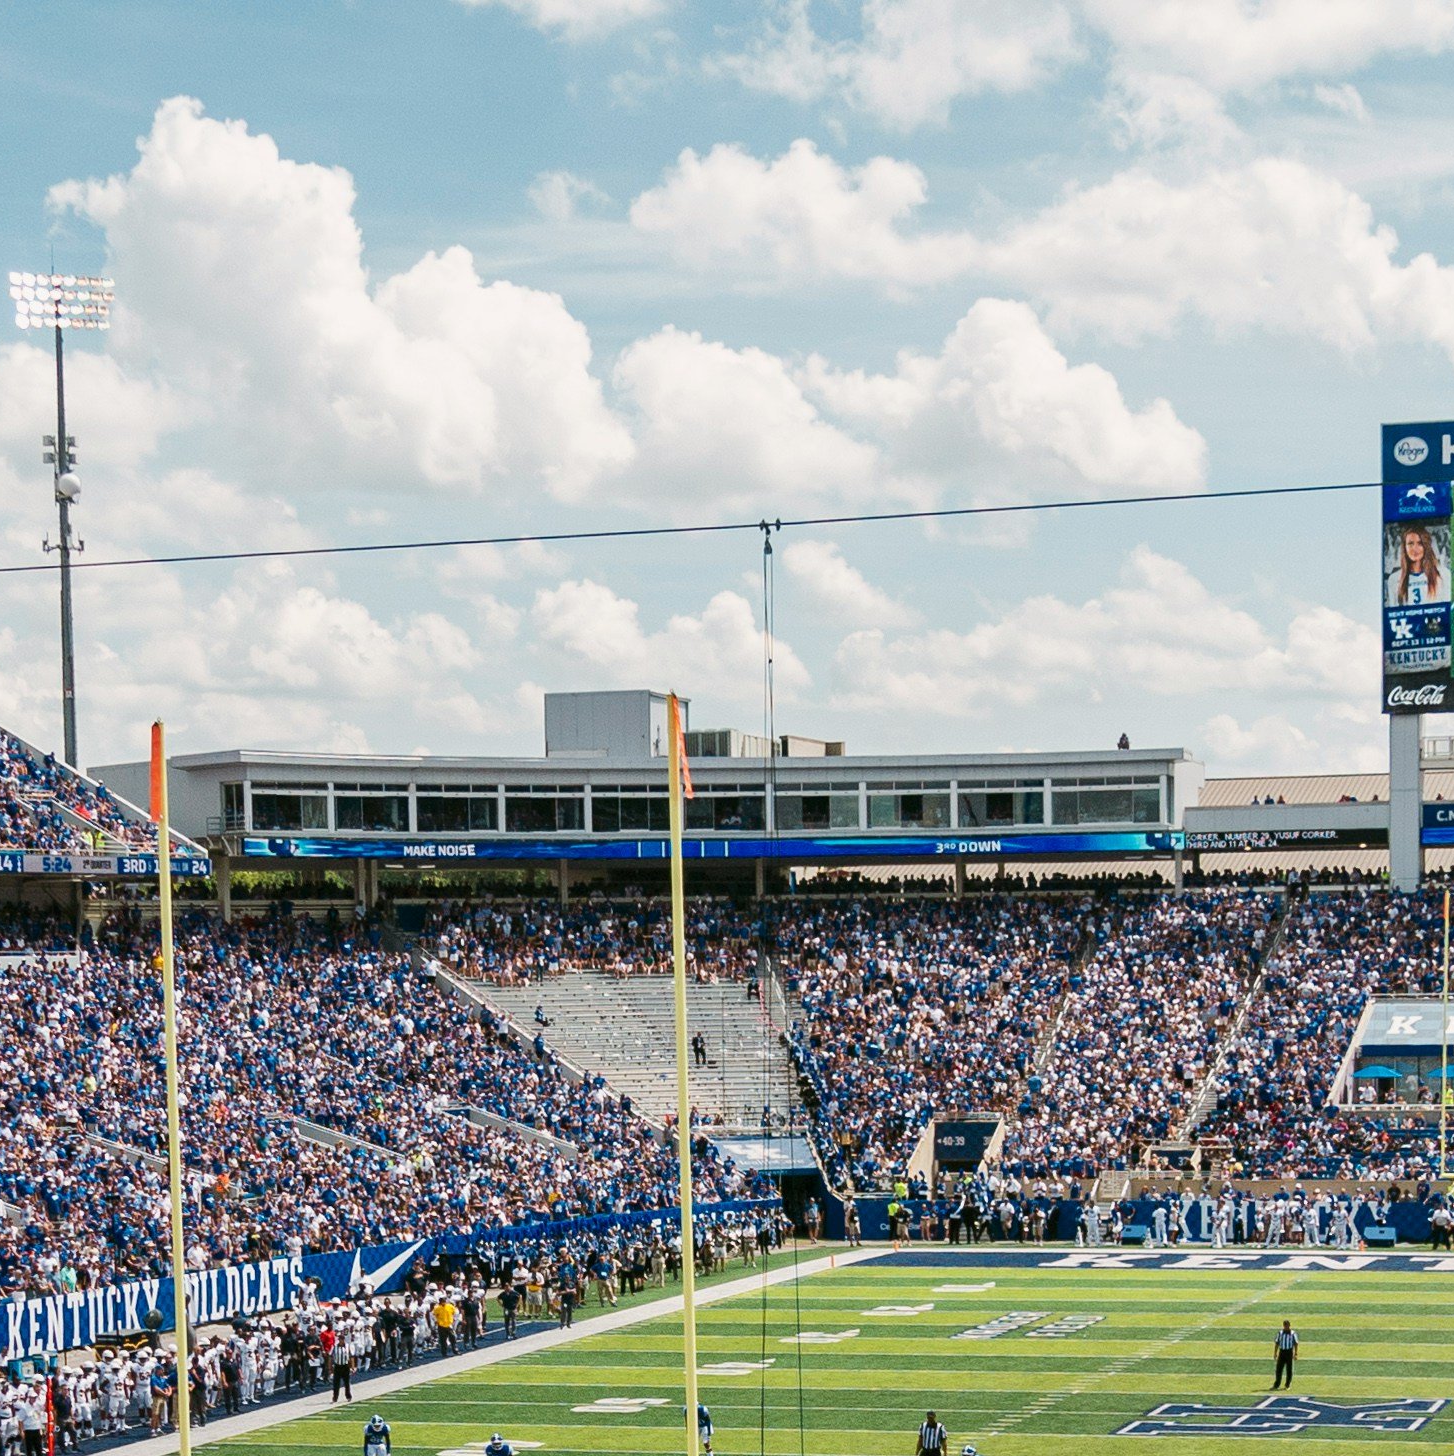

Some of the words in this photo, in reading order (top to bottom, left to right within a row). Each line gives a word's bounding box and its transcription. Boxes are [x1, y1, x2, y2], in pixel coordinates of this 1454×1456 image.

[403, 845, 436, 857] MAKE
[438, 844, 475, 857] NOISE
[958, 839, 1001, 853] DOWN
[42, 857, 72, 873] 5:24
[123, 859, 146, 873] 3RD
[192, 859, 208, 873] 24
[6, 1279, 160, 1361] KENTUCKY
